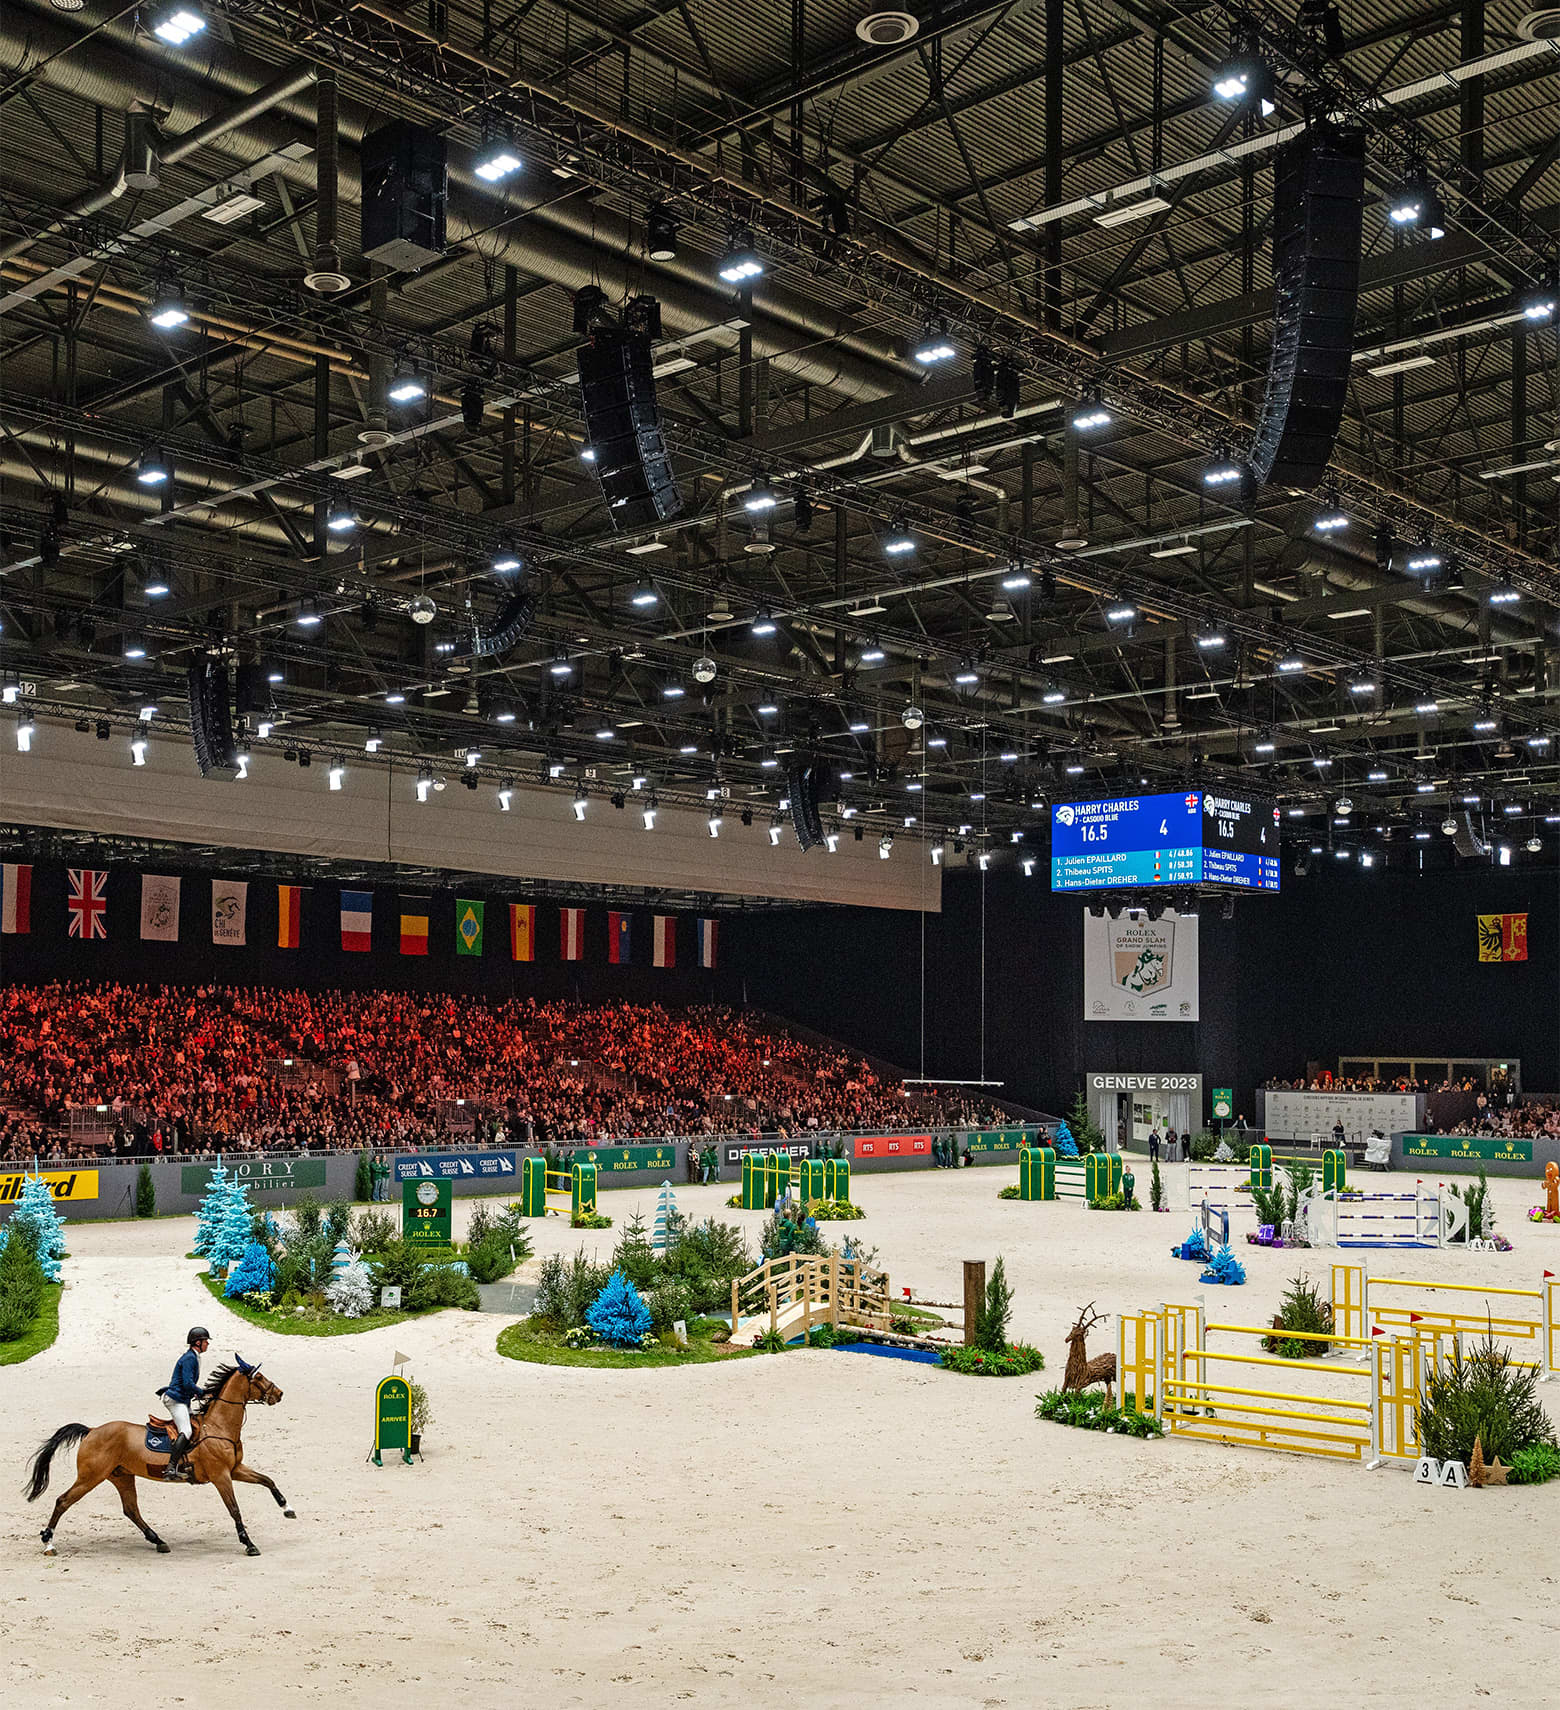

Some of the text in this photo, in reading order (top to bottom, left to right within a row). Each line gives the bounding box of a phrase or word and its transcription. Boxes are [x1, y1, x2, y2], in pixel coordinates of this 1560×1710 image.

[21, 683, 34, 694] 12
[1075, 800, 1139, 816] HARRY CHARLES
[1214, 798, 1251, 814] HARRY CHARLES
[1105, 814, 1119, 822] BLUE
[1081, 824, 1108, 842] 16.5
[1160, 819, 1168, 836] 4
[1218, 820, 1234, 838] 16.5
[1260, 827, 1266, 844] 4
[1064, 857, 1085, 865] Julien
[1087, 854, 1126, 863] EPAILLARD
[1064, 868, 1091, 876] Thibeau
[1092, 866, 1113, 874] SPITS
[1065, 878, 1106, 887] Hans-Dieter
[1107, 875, 1138, 884] DREHER
[1093, 1076, 1198, 1089] GENEVE 2023
[862, 1144, 873, 1152] RTS
[889, 1142, 899, 1150] RTS
[1451, 1150, 1481, 1158] ROLEX
[1495, 1152, 1525, 1160] ROLEX
[613, 1161, 638, 1170] ROLEX
[647, 1160, 670, 1168] ROLEX
[417, 1208, 437, 1217] 16.7
[1422, 1463, 1456, 1483] 3 A
